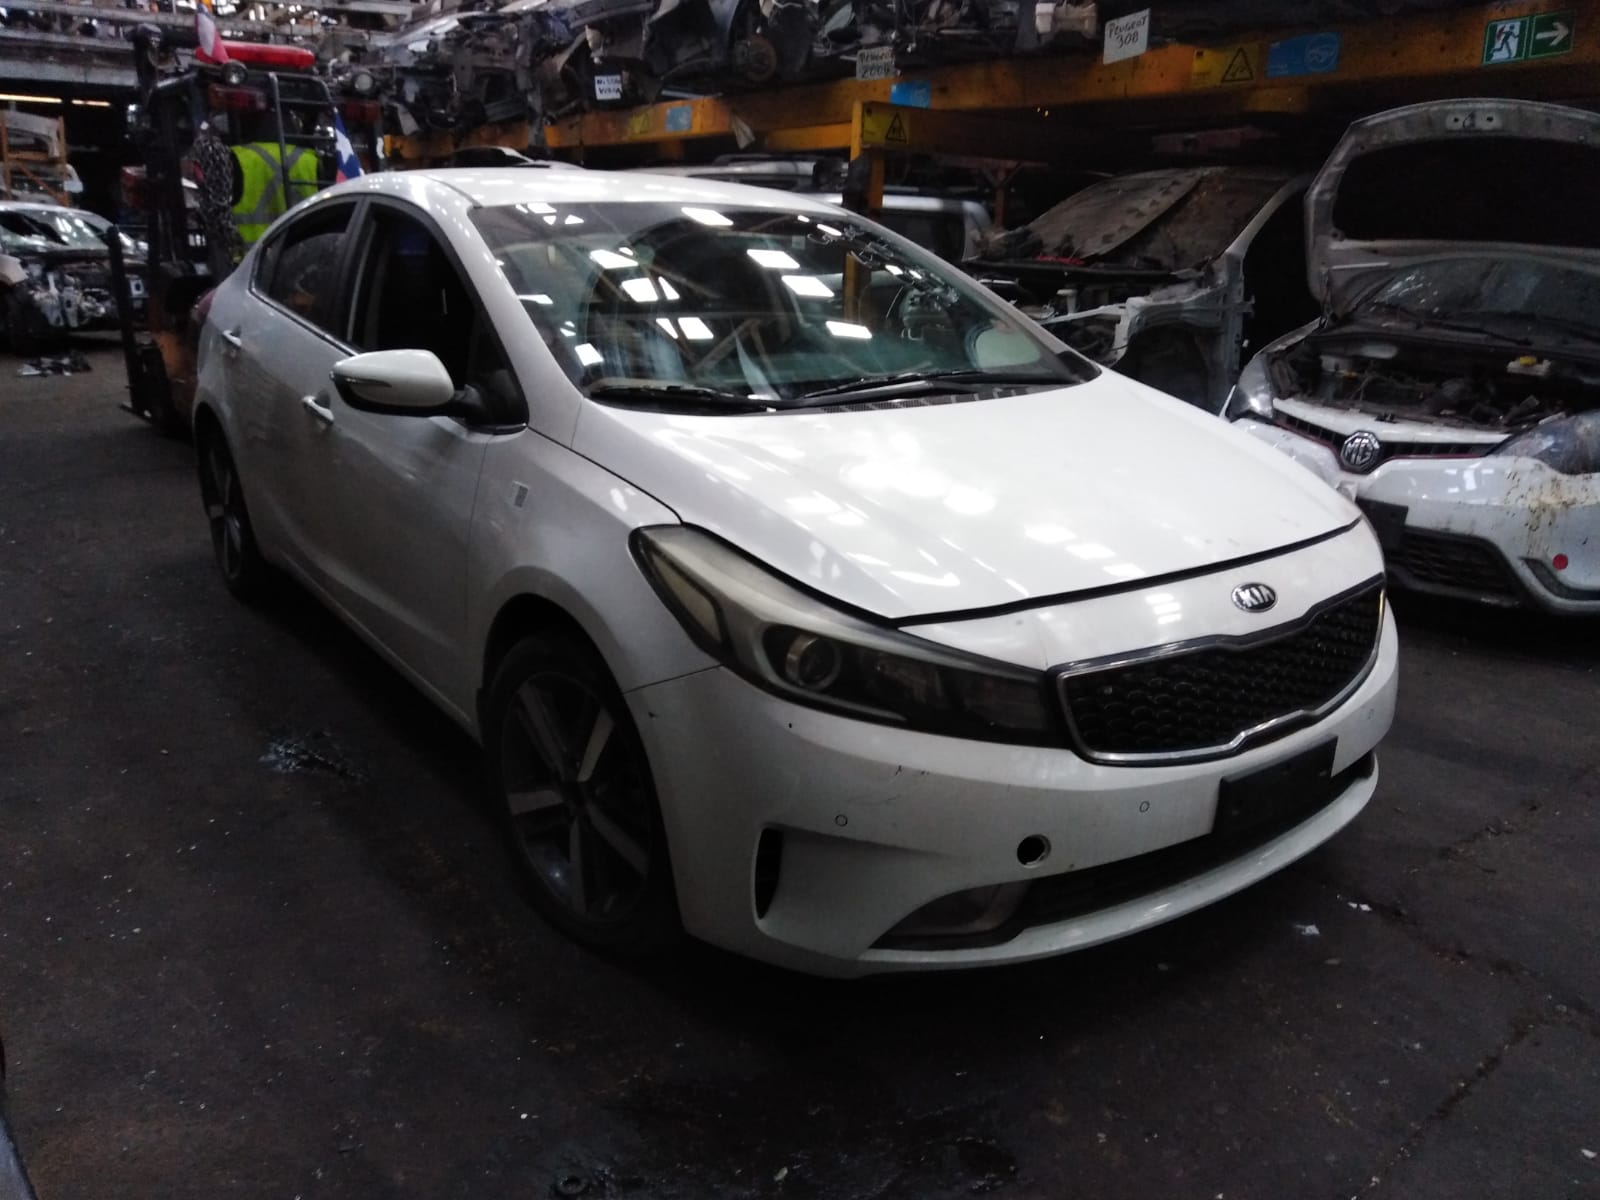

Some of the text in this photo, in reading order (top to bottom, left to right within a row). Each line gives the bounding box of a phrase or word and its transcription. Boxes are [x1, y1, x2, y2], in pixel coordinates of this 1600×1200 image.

[1116, 31, 1139, 48] 308
[1343, 435, 1375, 468] MG
[1237, 585, 1275, 608] KIA
